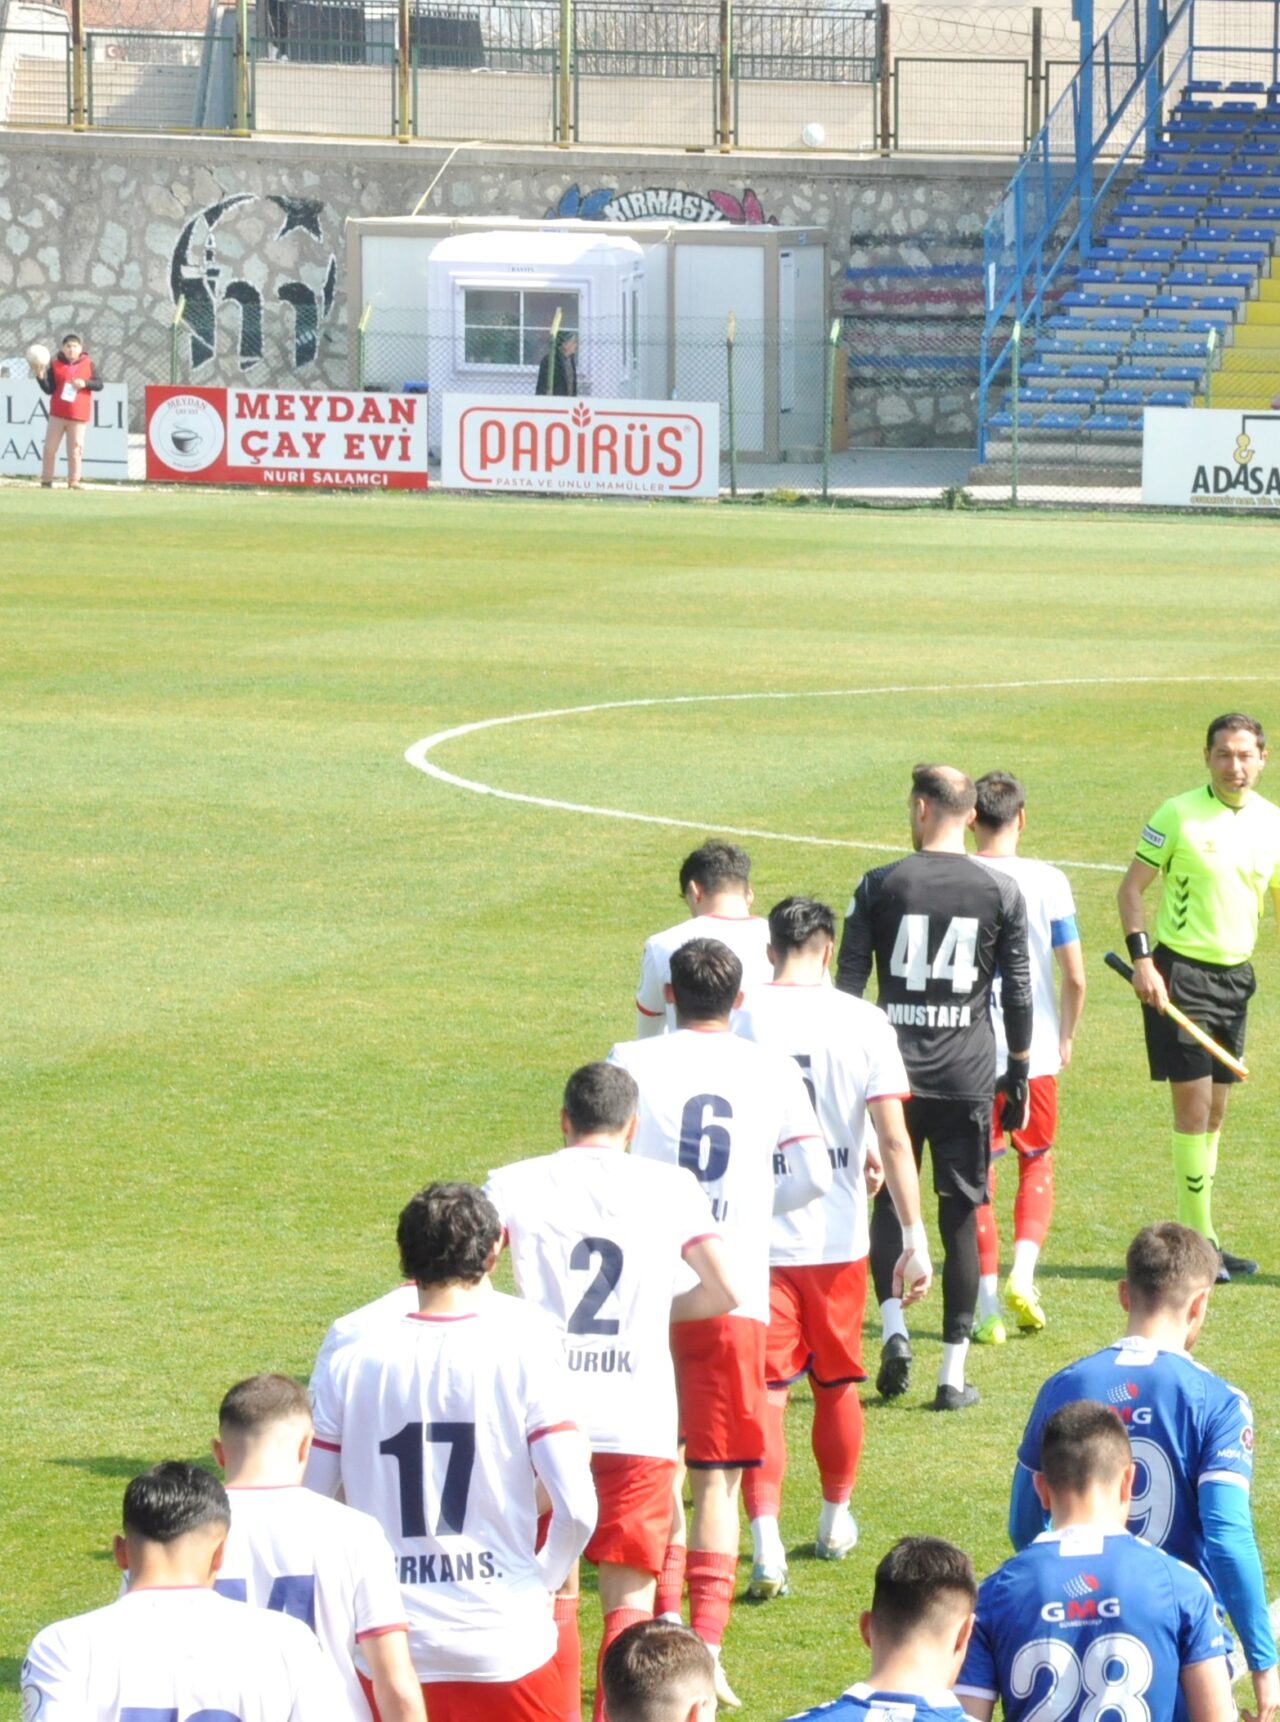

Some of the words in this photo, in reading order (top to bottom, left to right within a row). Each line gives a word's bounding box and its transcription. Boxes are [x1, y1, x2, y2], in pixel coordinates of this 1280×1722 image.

[235, 393, 417, 424] MEYDAN
[241, 430, 326, 465] ÇAY
[344, 427, 411, 462] EVİ
[480, 417, 683, 478] PAPİRÜS
[263, 467, 305, 484] NURİ
[313, 471, 388, 486] SALAMCI
[496, 478, 533, 488] PASTA
[537, 479, 553, 489] VE
[558, 480, 591, 489] UNLU
[596, 481, 665, 492] MAMÜLLER
[889, 913, 979, 994] 44
[886, 1003, 972, 1028] MUSTAFA
[678, 1093, 734, 1183] 6
[566, 1236, 624, 1336] 2
[379, 1421, 477, 1539] 17
[394, 1552, 475, 1585] RKAN
[1041, 1598, 1121, 1623] GMG
[1009, 1633, 1154, 1722] 28
